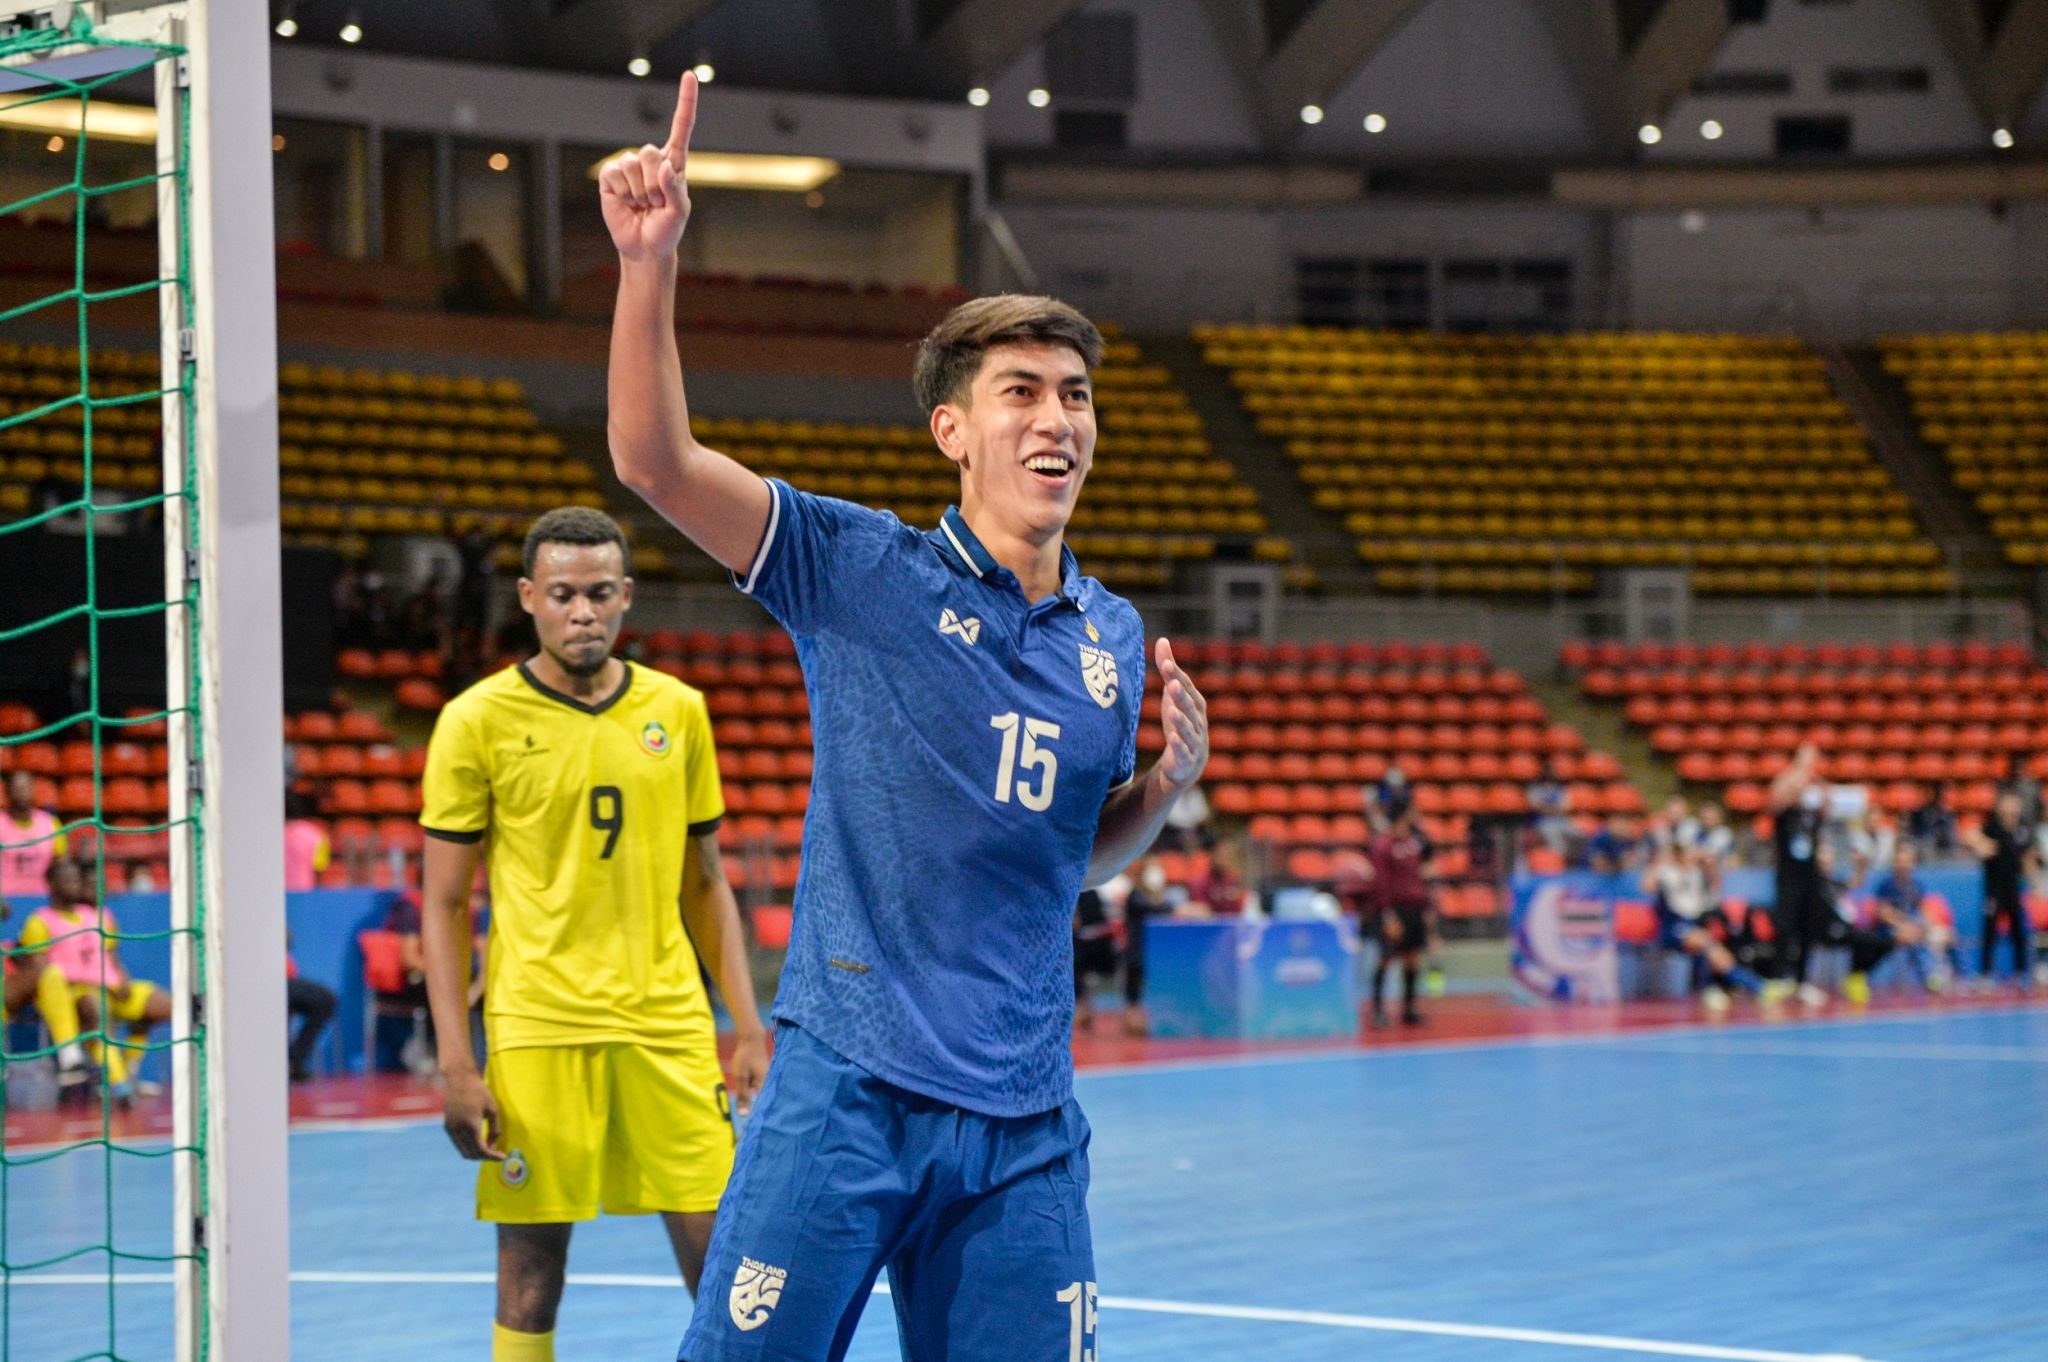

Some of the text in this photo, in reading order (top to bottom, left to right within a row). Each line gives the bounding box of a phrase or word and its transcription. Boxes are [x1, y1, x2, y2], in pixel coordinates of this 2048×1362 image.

[990, 711, 1060, 812] 15
[590, 785, 624, 860] 9
[742, 1256, 788, 1280] THAILAND
